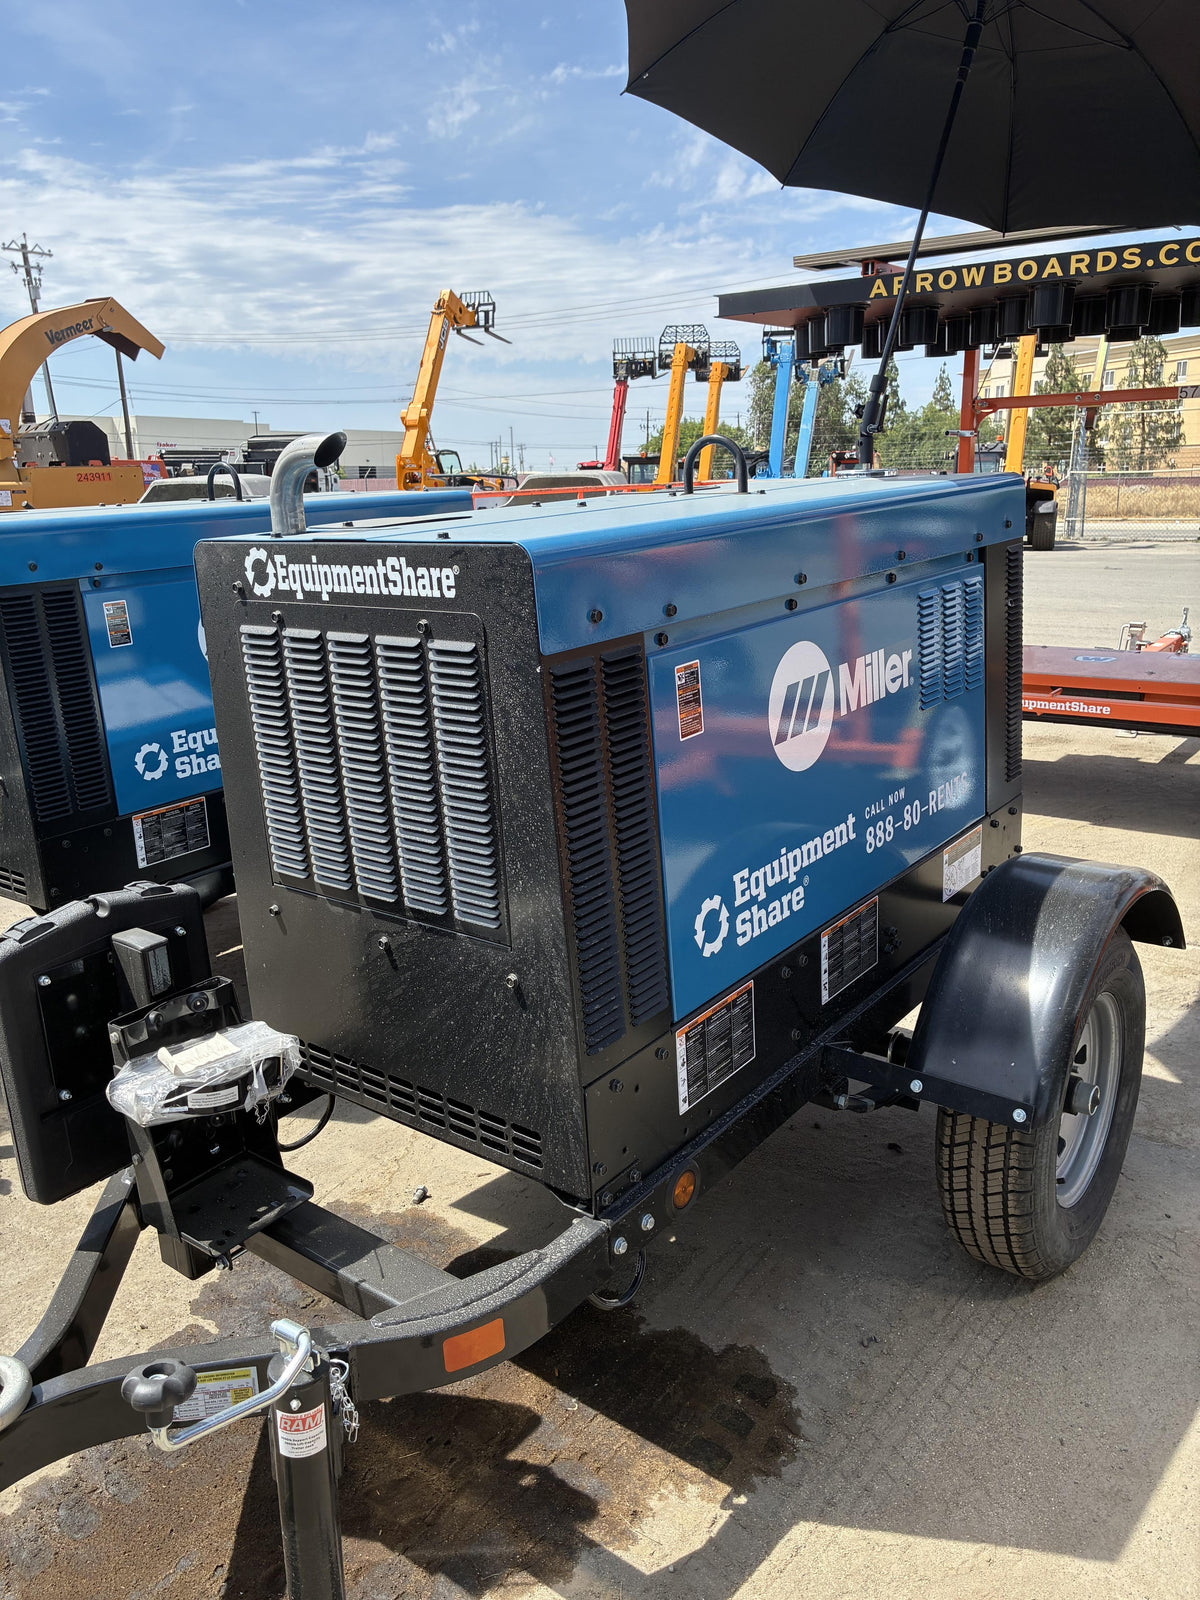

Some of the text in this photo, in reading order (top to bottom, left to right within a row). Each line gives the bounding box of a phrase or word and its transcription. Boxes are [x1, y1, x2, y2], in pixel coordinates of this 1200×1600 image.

[44, 317, 94, 345] Vermeer
[439, 316, 449, 350] JCB
[77, 472, 112, 482] 243911
[838, 648, 912, 717] Miller
[864, 786, 906, 819] CALL NOW
[865, 771, 969, 854] 888-80-RENTS
[732, 813, 857, 908] Equipment
[280, 1412, 322, 1431] RAM
